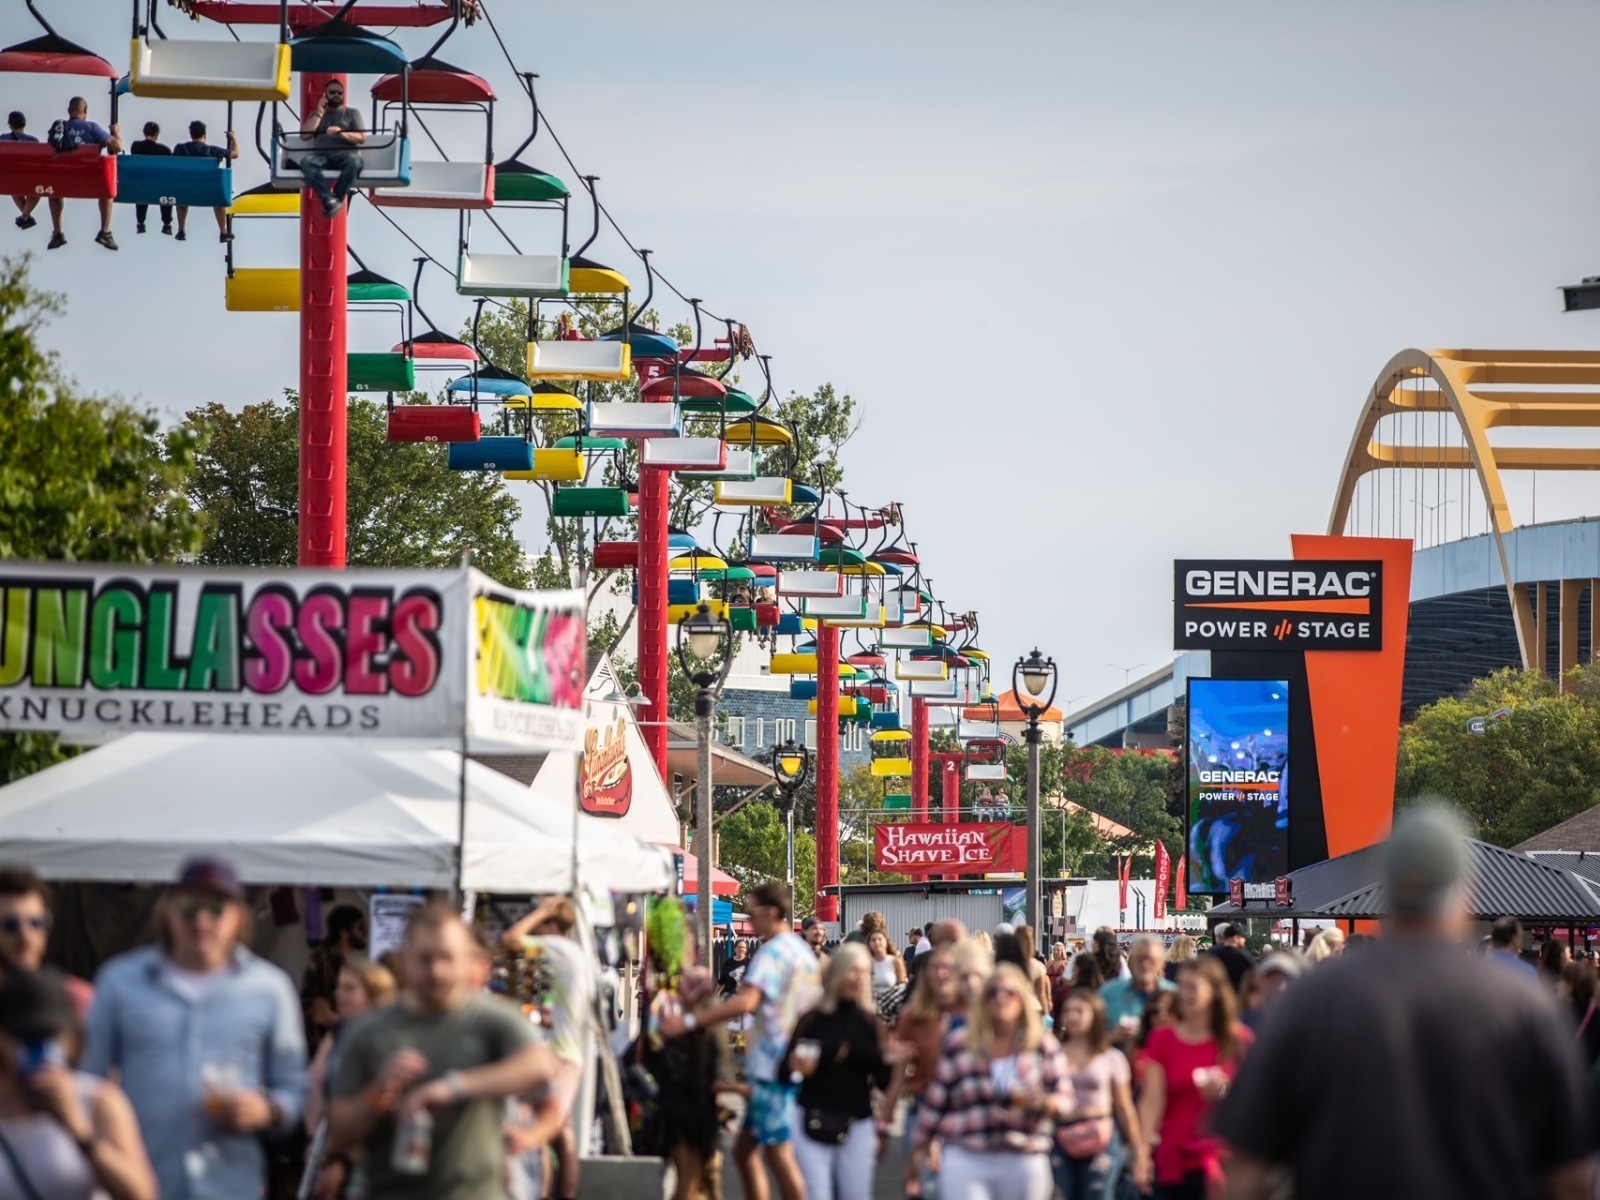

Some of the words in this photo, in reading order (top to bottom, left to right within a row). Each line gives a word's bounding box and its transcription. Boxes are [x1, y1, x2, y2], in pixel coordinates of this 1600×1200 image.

[35, 185, 55, 195] 64
[159, 196, 177, 205] 63
[647, 365, 660, 377] 5
[1185, 621, 1267, 638] POWER
[1298, 622, 1370, 638] STAGE
[946, 760, 955, 771] 2
[1199, 792, 1235, 801] POWER
[1247, 792, 1279, 801] STAGE
[881, 846, 955, 866] SHAVE
[957, 845, 993, 864] ICE
